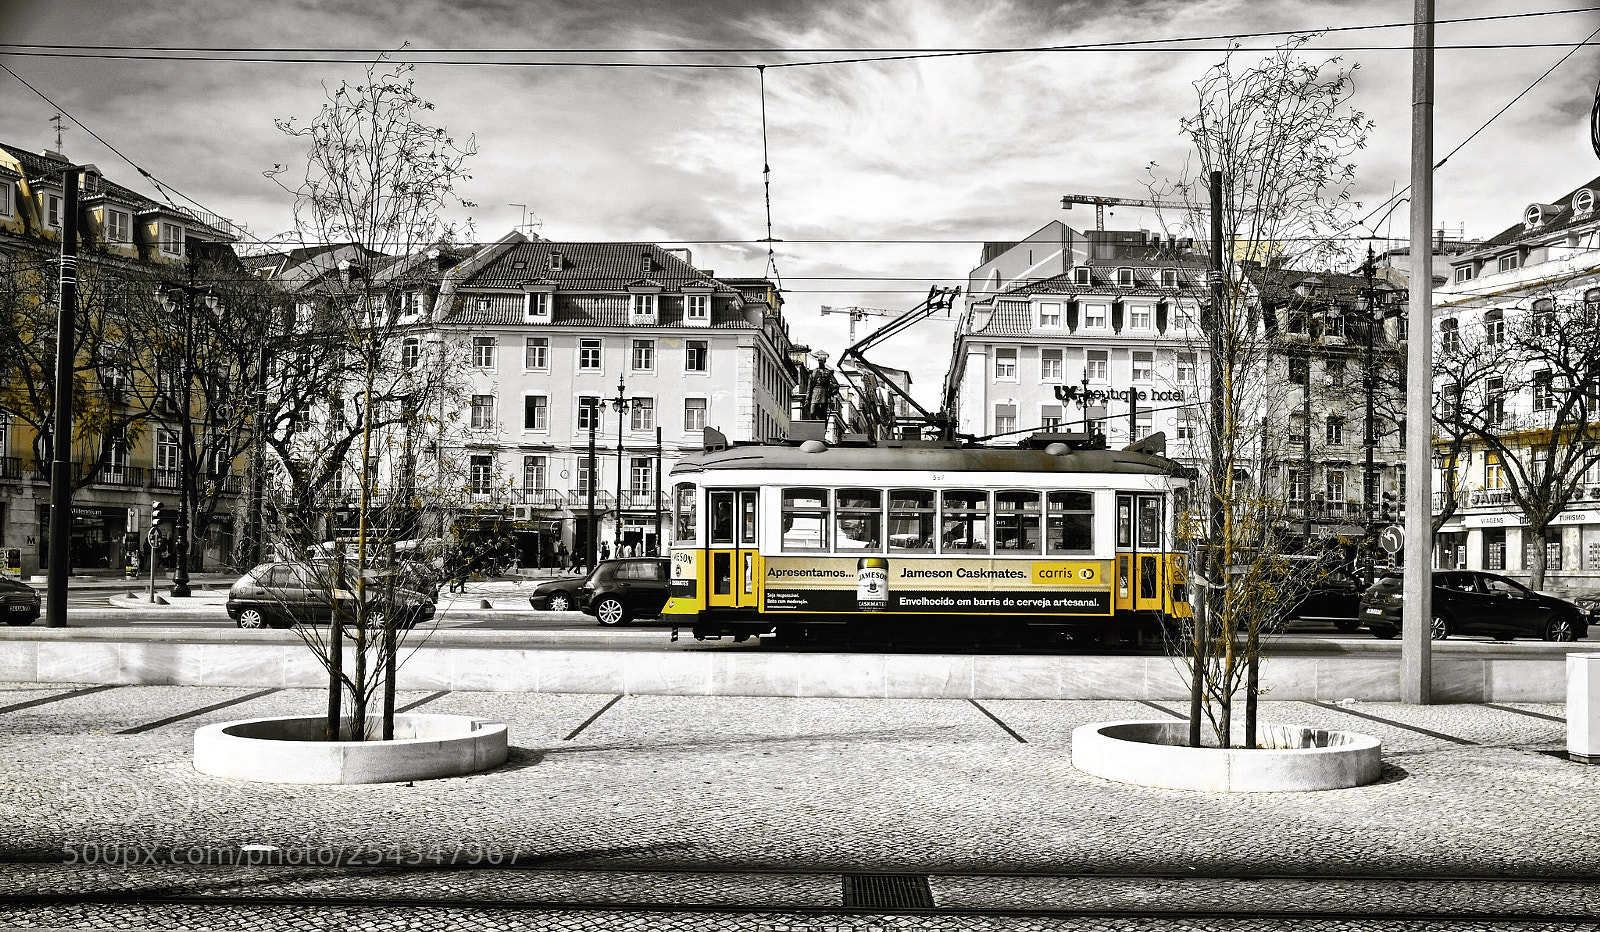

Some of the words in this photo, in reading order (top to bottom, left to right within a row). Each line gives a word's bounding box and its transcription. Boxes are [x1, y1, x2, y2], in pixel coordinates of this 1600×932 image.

[1470, 492, 1514, 505] JAME
[767, 567, 855, 579] Apresentamos...
[900, 567, 953, 578] Jameson
[956, 567, 1027, 579] Caskmates.
[1038, 567, 1073, 578] carris
[899, 596, 955, 606] Envelhecido
[973, 597, 1001, 606] barris
[1002, 597, 1014, 606] de
[1016, 597, 1051, 609] cerveja
[1053, 597, 1100, 607] artesanal.
